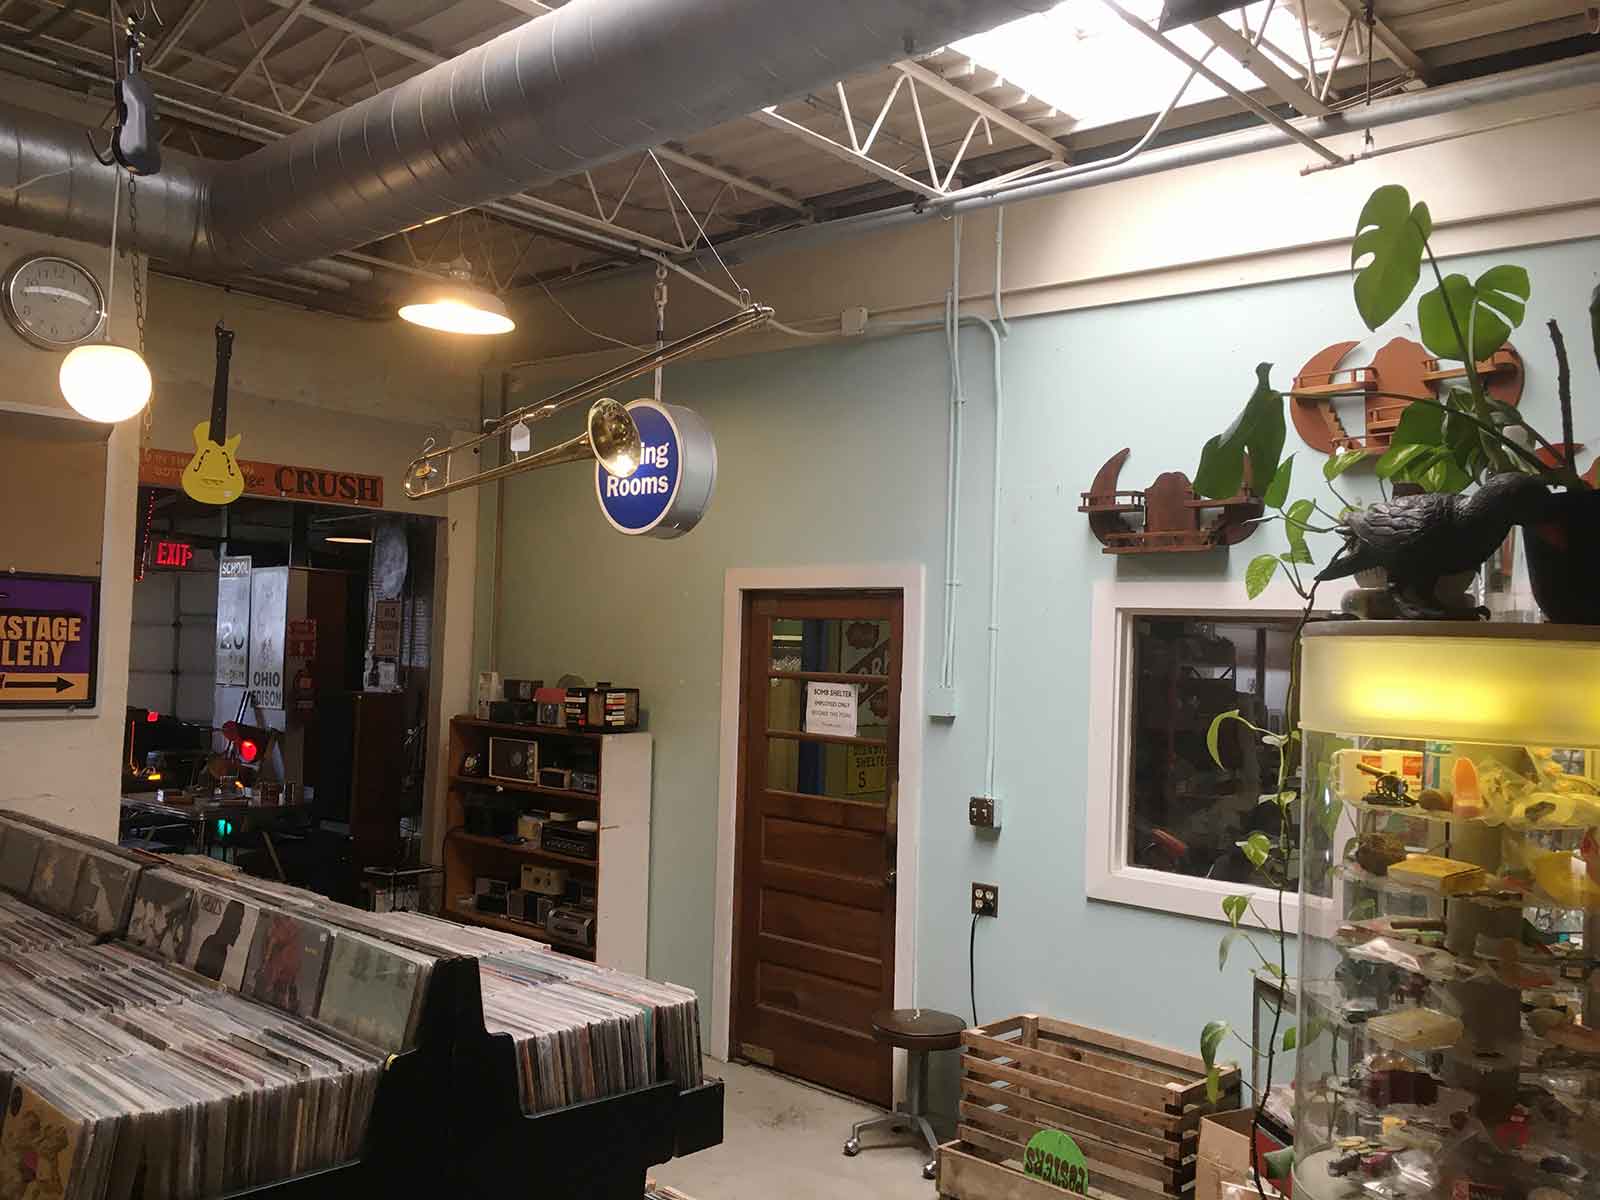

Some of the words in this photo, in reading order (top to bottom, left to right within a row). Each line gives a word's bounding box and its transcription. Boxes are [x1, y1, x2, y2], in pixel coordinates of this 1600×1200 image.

[275, 466, 379, 501] CRUSH
[606, 475, 669, 498] Rooms
[157, 543, 191, 567] EXIT
[221, 560, 249, 575] SCHOOL
[253, 671, 281, 688] OHIO
[251, 689, 282, 708] EDISON
[830, 689, 852, 698] SHELTER
